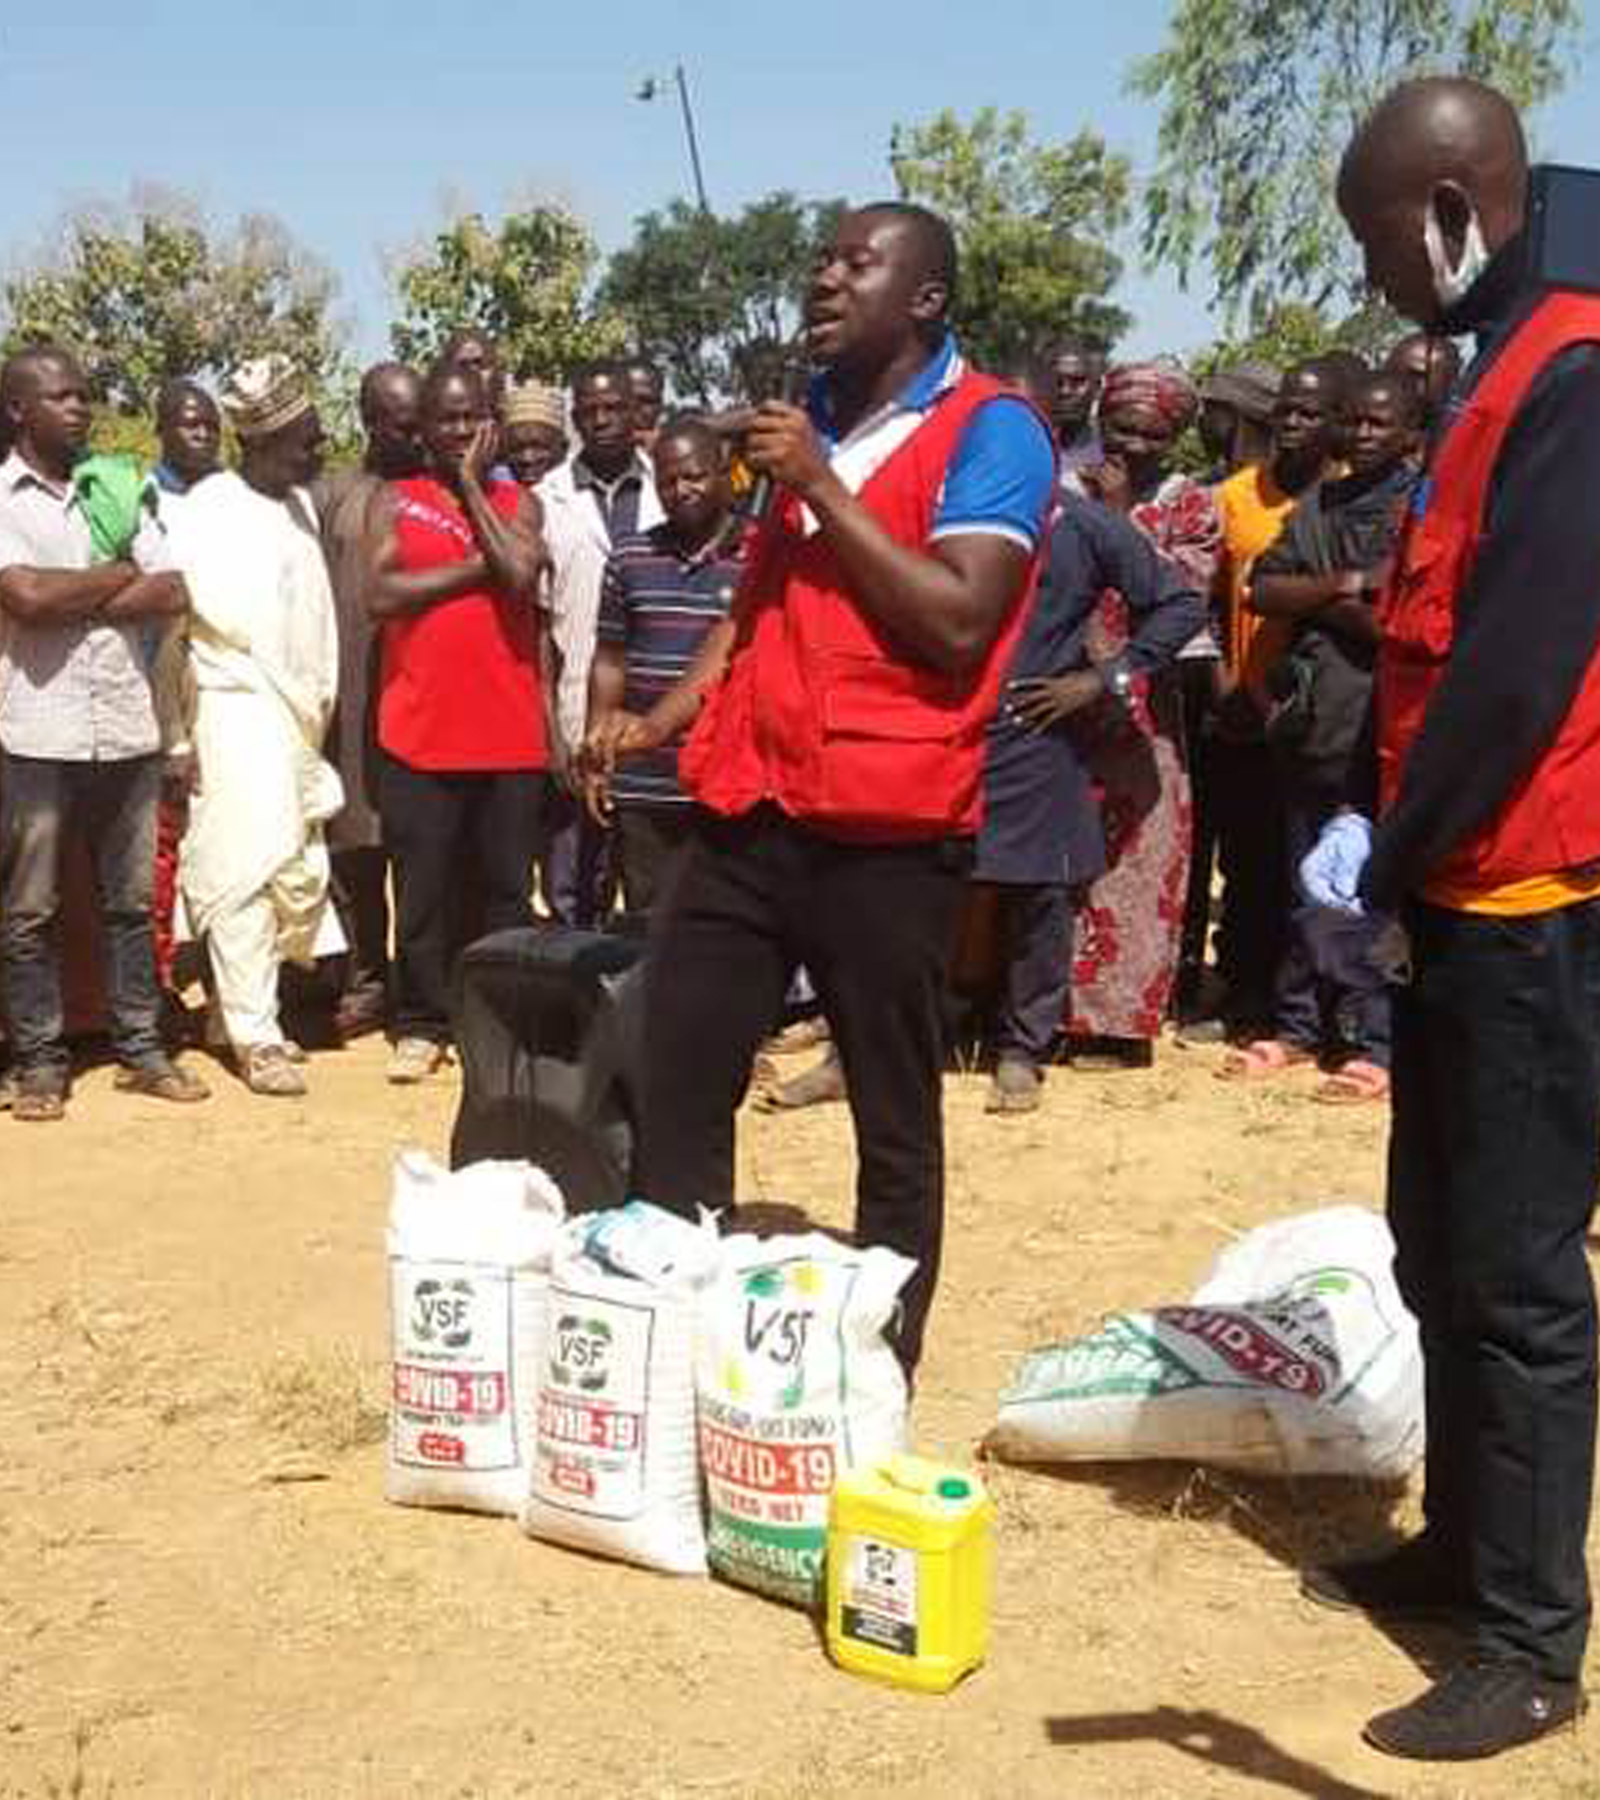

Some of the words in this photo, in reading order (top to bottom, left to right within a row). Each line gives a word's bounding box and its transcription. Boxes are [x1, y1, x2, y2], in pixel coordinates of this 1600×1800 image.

[420, 1299, 467, 1328] VSF
[560, 1335, 604, 1366] VSF
[1164, 1309, 1308, 1389] VID-19
[701, 1427, 834, 1491] COVID-19
